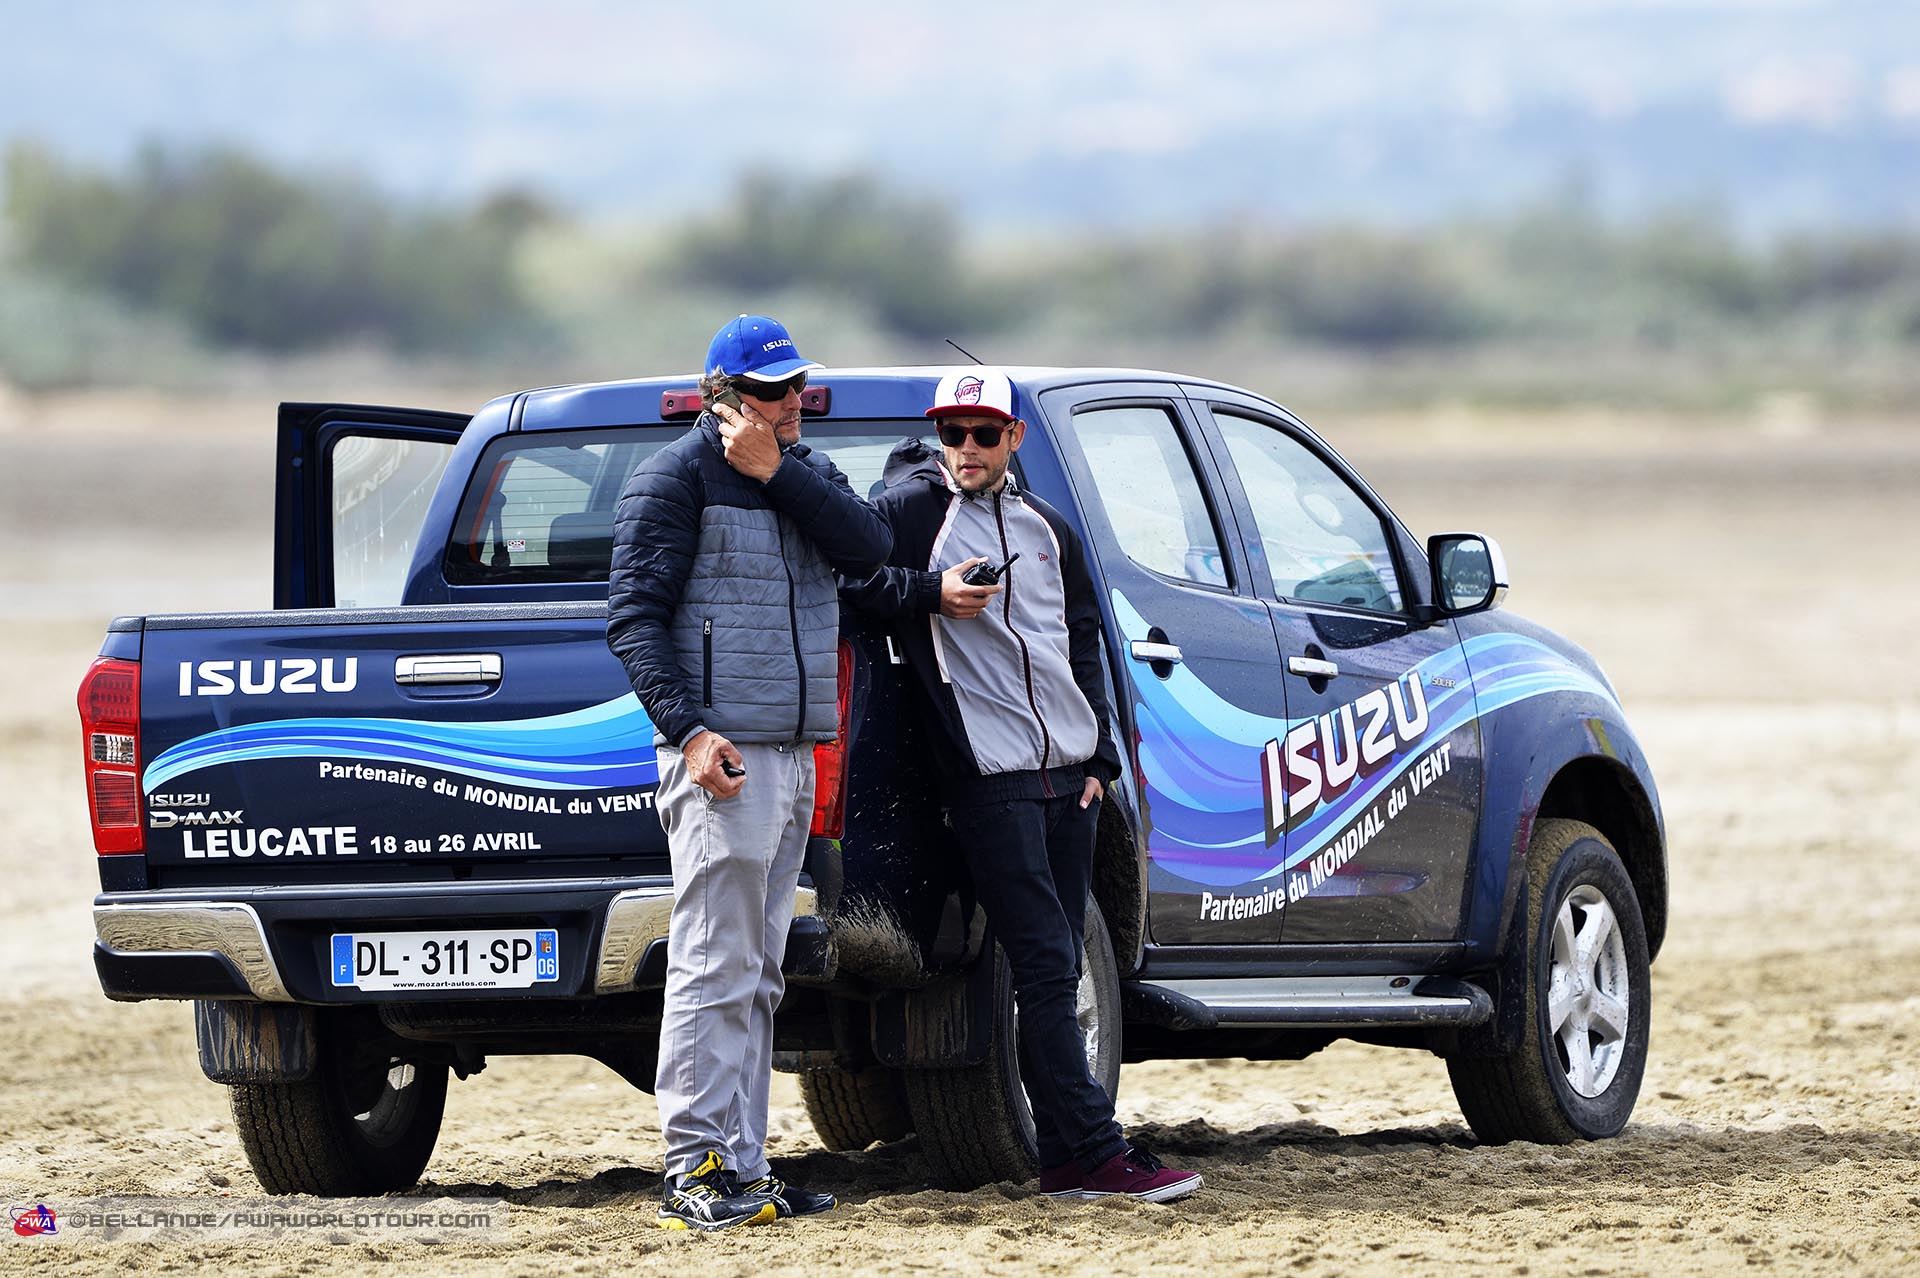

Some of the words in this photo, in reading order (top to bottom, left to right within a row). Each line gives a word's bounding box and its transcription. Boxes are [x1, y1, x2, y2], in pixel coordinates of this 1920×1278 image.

[762, 339, 792, 352] ISUZU
[178, 657, 358, 697] ISUZU
[1264, 672, 1429, 831] ISUZU
[319, 761, 428, 789] Partenaire
[433, 778, 459, 798] du
[464, 784, 562, 814] MONDIAL
[567, 798, 593, 814] du
[597, 791, 654, 813] VENT
[149, 793, 211, 808] ISUZU
[149, 810, 244, 828] D-MAX
[1200, 886, 1286, 921] Partenaire
[1288, 872, 1309, 904] du
[1309, 806, 1386, 889] MONDIAL
[1387, 785, 1408, 820] du
[1408, 742, 1451, 797] VENT
[182, 826, 359, 859] LEUCATE
[370, 835, 398, 854] 18
[404, 839, 432, 853] au
[438, 833, 466, 852] 26
[472, 832, 542, 851] AVRIL
[340, 964, 348, 976] F
[537, 957, 556, 976] 06
[392, 980, 497, 988] www.mozart-autos.com
